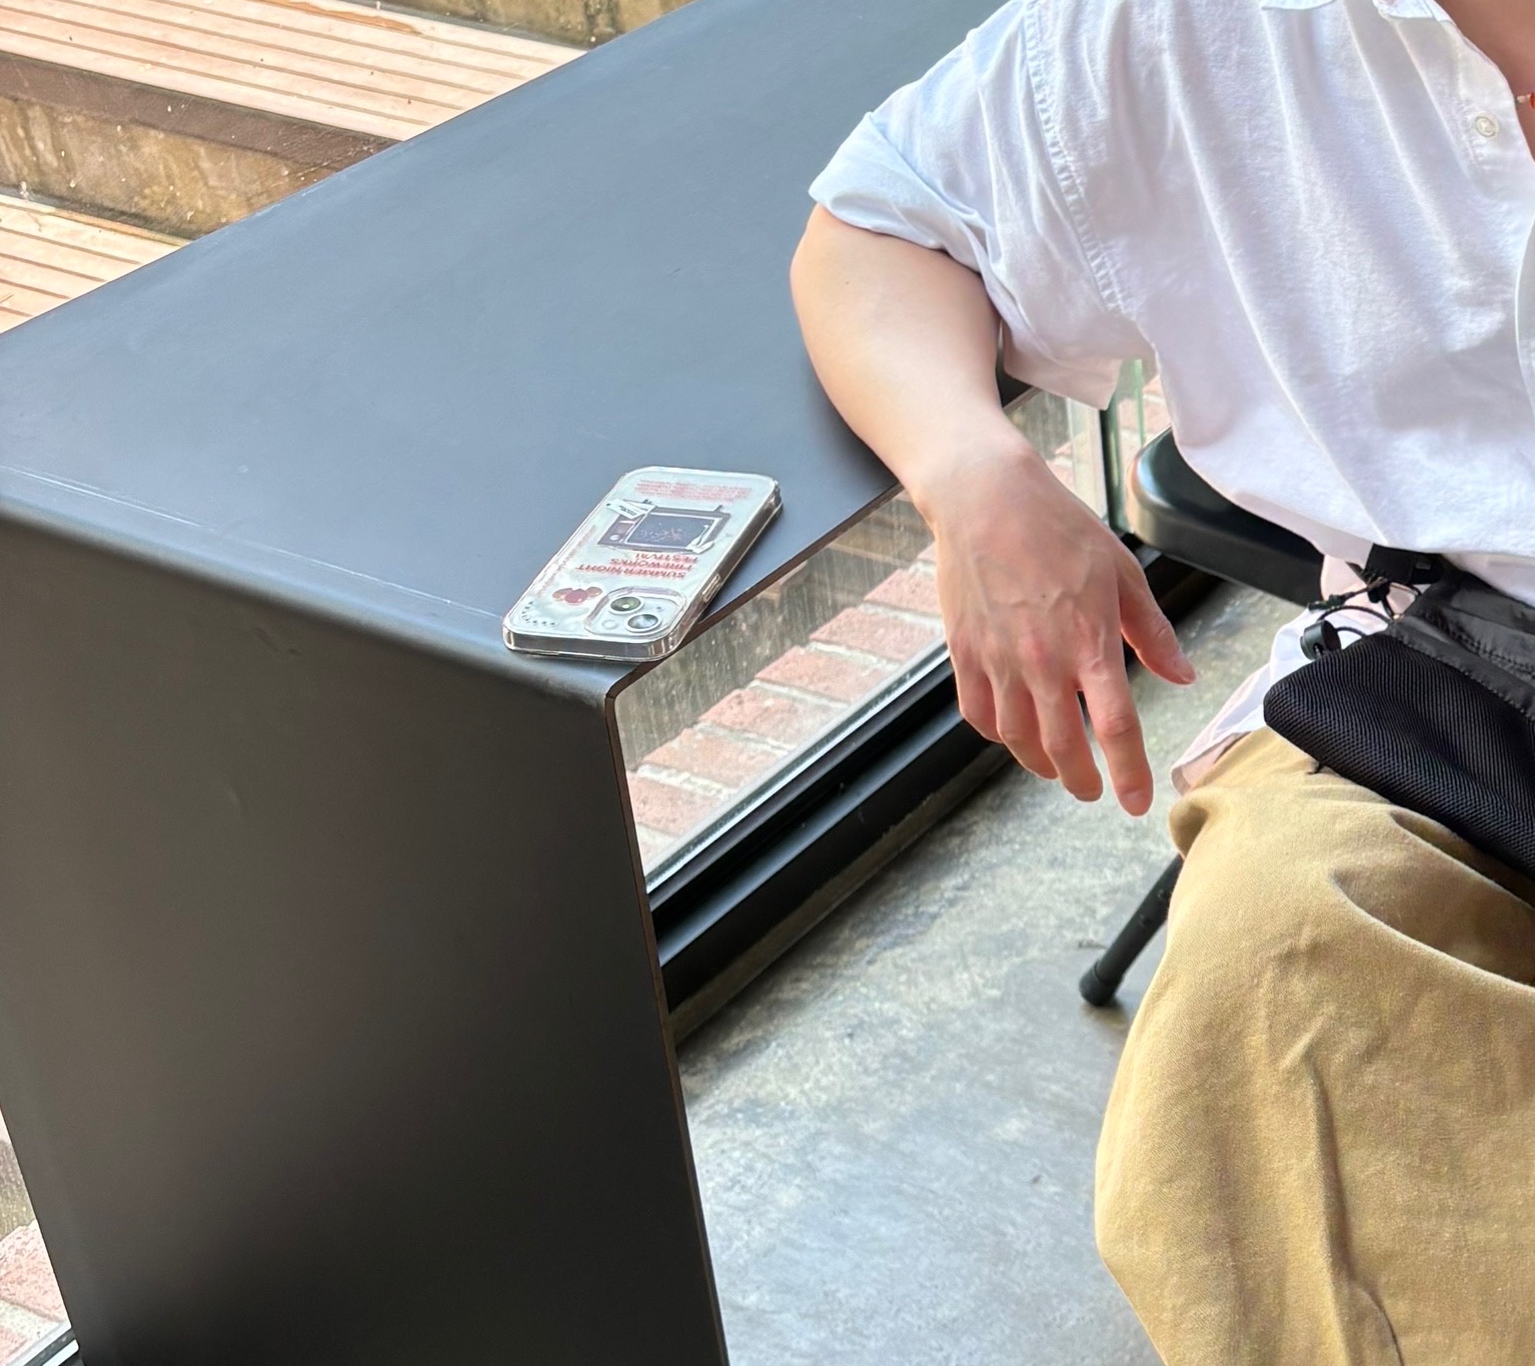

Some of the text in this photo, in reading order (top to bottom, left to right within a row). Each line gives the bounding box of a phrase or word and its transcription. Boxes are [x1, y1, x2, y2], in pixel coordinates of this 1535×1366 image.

[576, 564, 687, 579] SUMMER NIGHT
[609, 559, 693, 571] FIREWORKS
